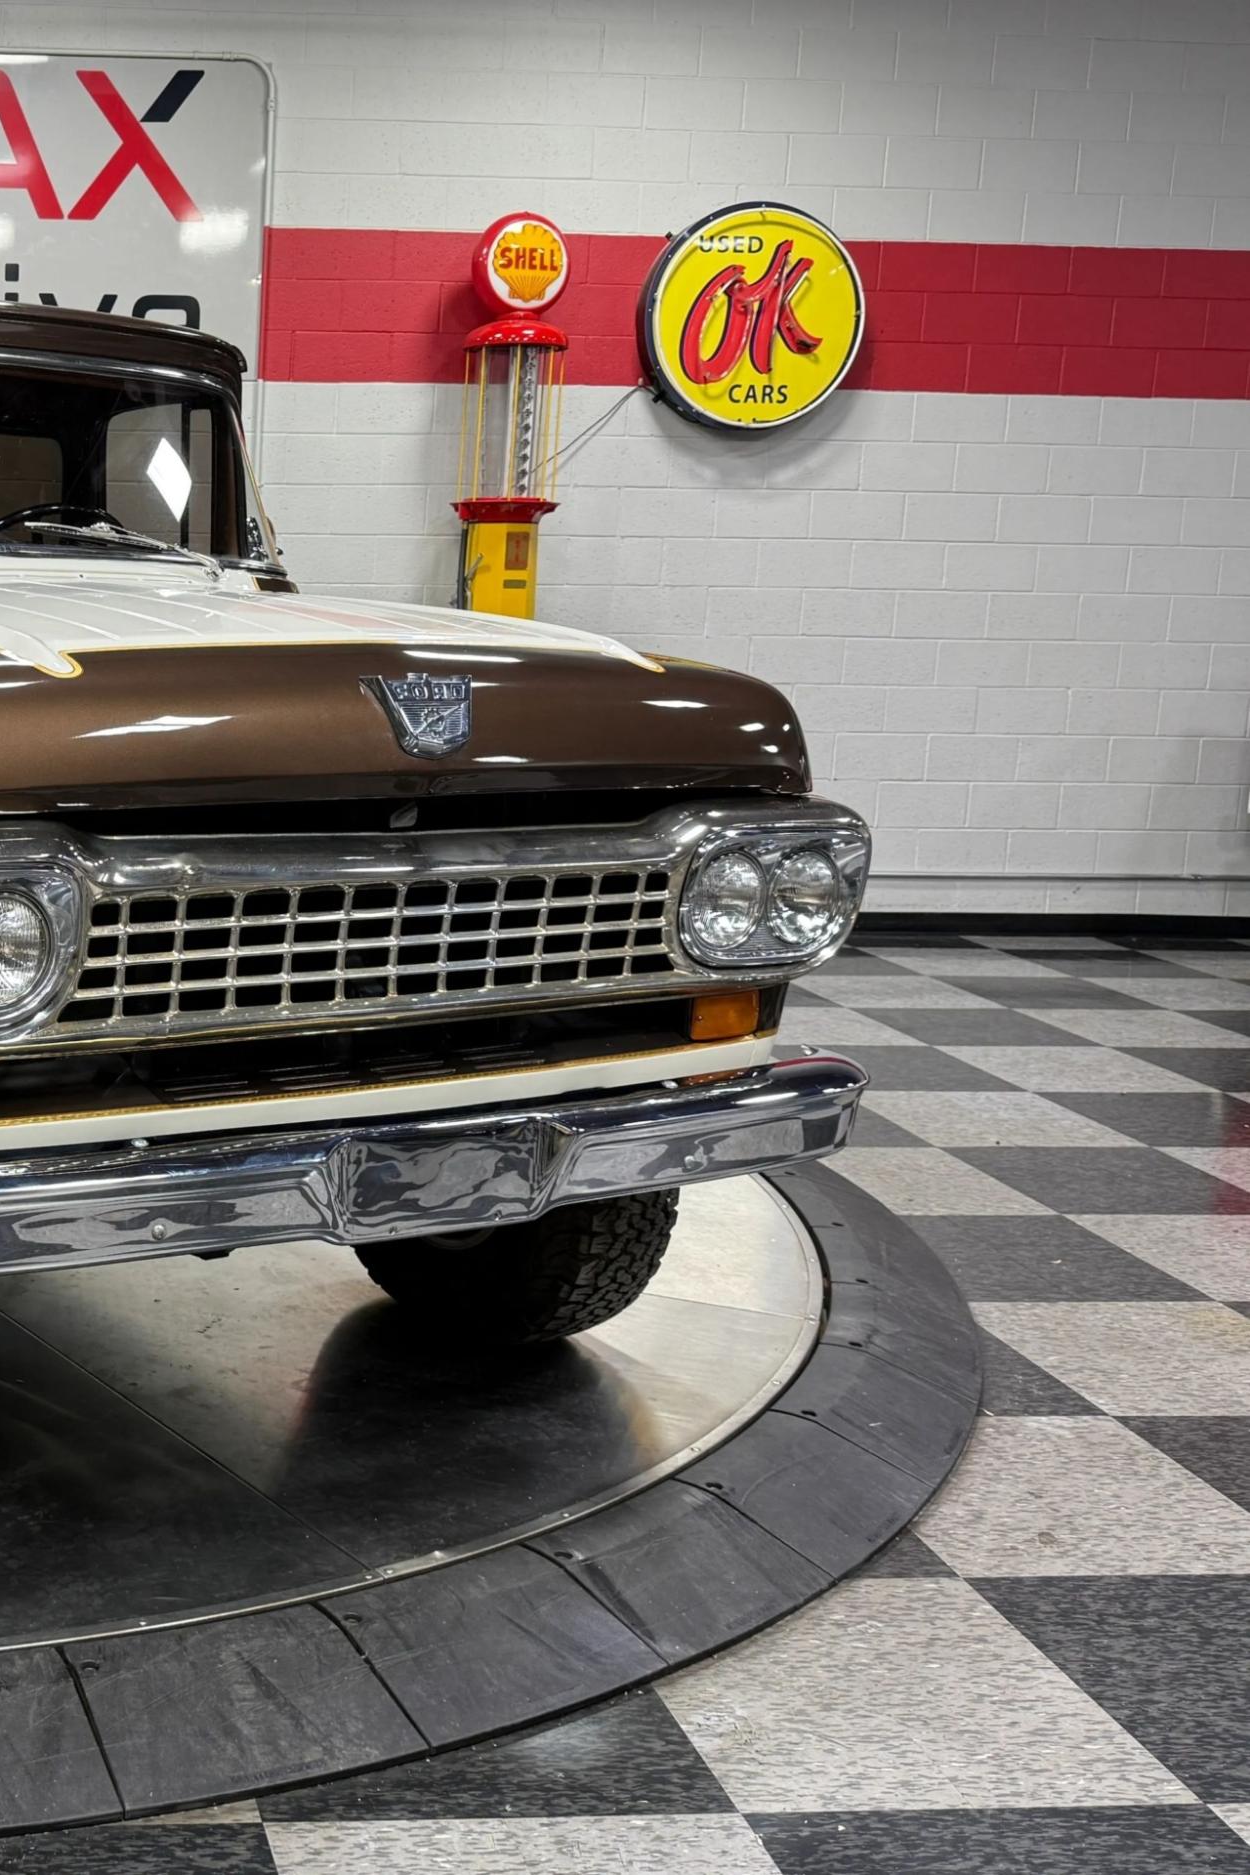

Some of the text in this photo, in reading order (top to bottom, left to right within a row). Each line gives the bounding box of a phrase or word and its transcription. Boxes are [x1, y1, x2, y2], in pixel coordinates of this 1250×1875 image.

[699, 235, 763, 254] USED
[499, 246, 559, 272] SHELL
[680, 239, 823, 384] OK
[729, 384, 788, 404] CARS
